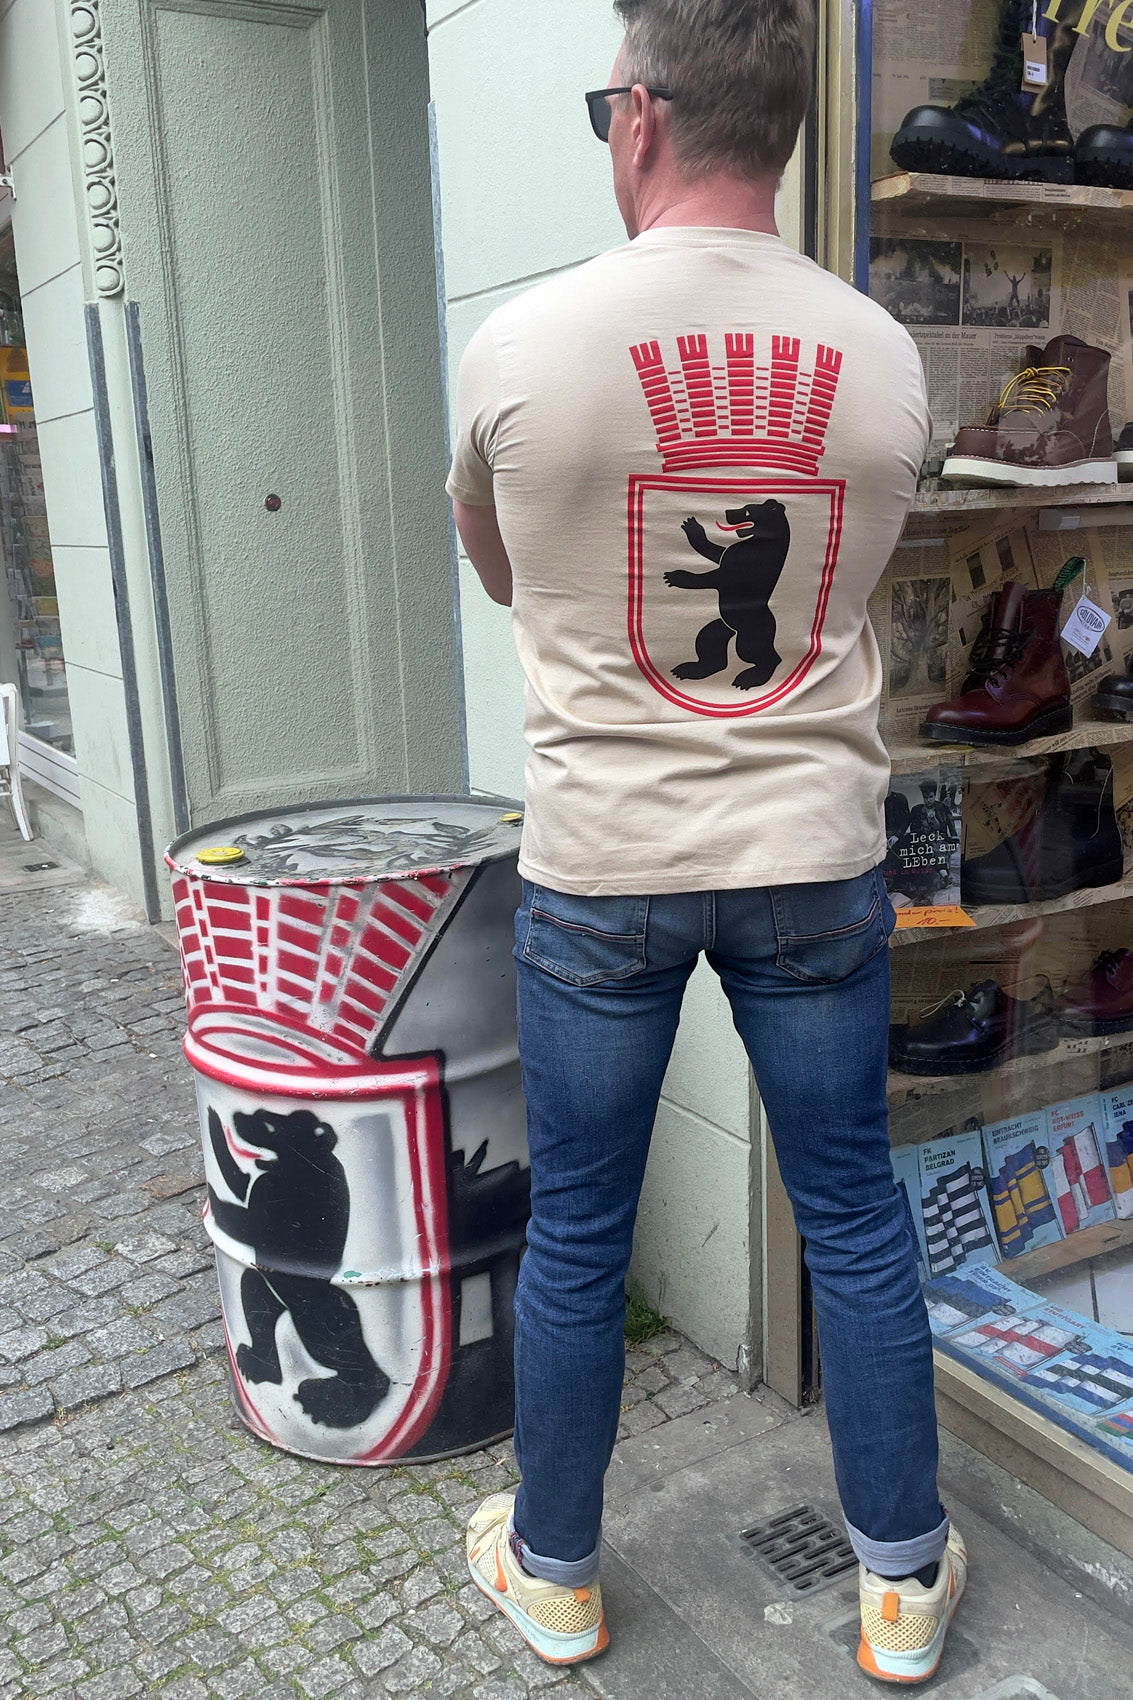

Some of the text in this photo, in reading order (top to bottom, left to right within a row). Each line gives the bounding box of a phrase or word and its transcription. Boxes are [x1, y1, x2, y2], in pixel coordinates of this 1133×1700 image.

[910, 831, 945, 844] Leck
[899, 843, 956, 857] mich am
[903, 856, 946, 869] LEben
[1112, 1102, 1126, 1110] CARL
[992, 1122, 1022, 1137] EINTRACHT
[1053, 1121, 1074, 1132] ERFURT
[993, 1125, 1039, 1144] BRAUNSCHWEIG
[923, 1147, 932, 1155] FK
[924, 1149, 956, 1163] PARTIZAN
[925, 1158, 955, 1171] BELGRAD
[974, 1267, 1012, 1292] EINTRACHT
